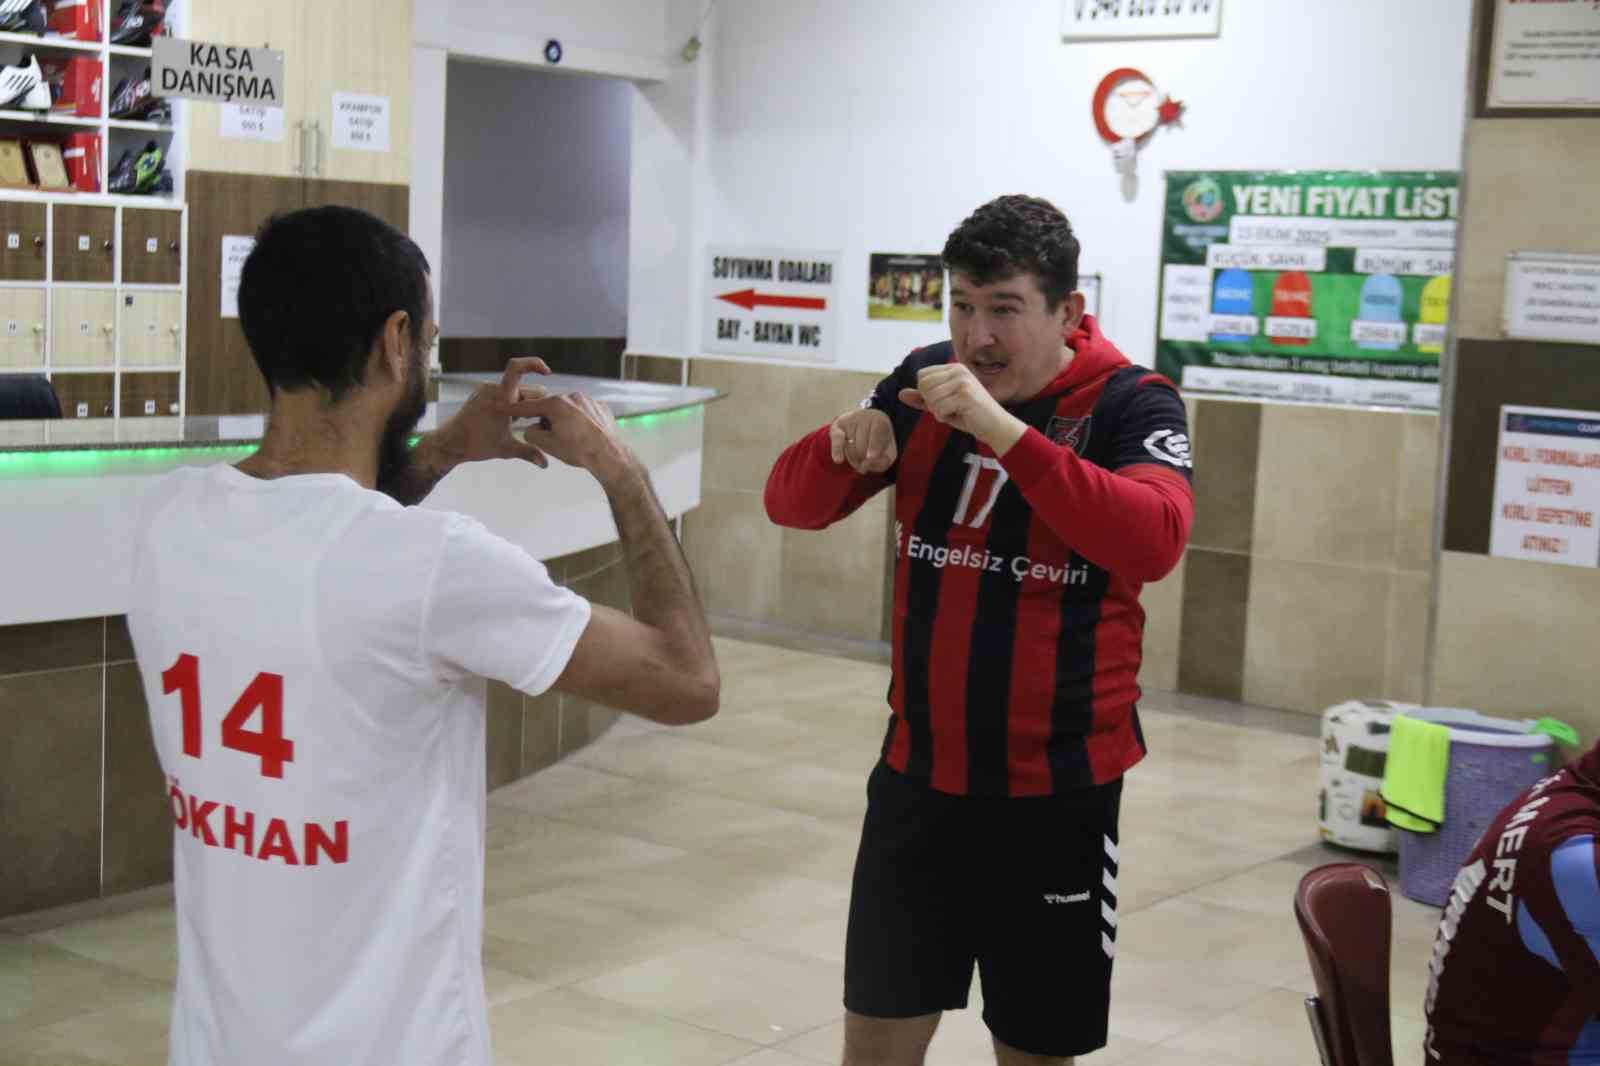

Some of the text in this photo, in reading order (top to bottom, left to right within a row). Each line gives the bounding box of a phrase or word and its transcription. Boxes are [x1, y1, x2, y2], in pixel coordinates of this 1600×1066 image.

[190, 43, 253, 71] KASA
[162, 67, 275, 102] DANIŞMA
[717, 318, 741, 341] BAY
[753, 320, 794, 344] BAYAN
[798, 324, 821, 348] WC
[952, 452, 1009, 528] 17
[907, 535, 1089, 585] Engelsiz Çeviri
[161, 652, 295, 780] 14
